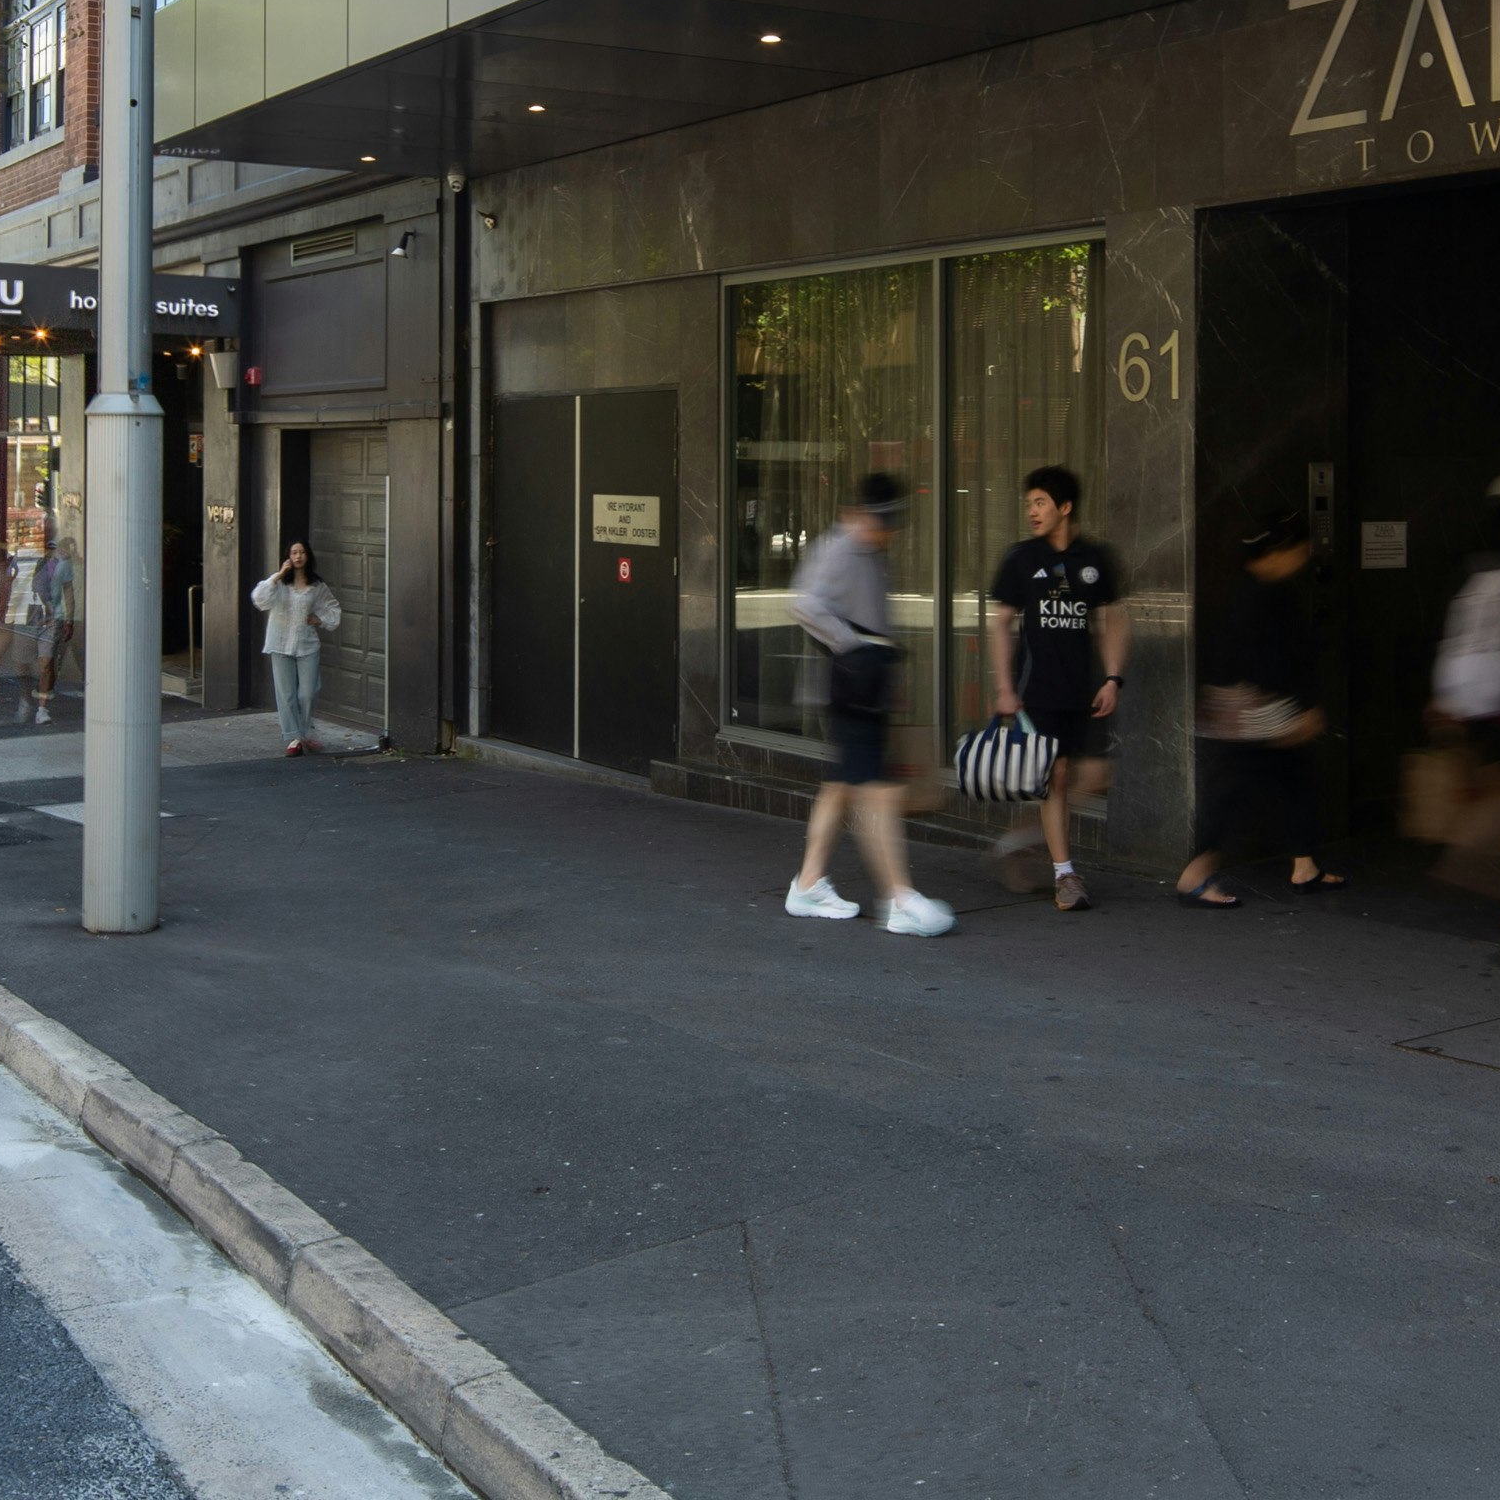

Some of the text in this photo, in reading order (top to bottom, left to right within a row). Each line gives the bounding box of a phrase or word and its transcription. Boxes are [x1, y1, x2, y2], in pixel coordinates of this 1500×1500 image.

[155, 298, 219, 317] suites
[1117, 329, 1182, 403] 61
[618, 515, 631, 524] AND
[1040, 600, 1087, 616] KING
[1041, 617, 1086, 629] POWER
